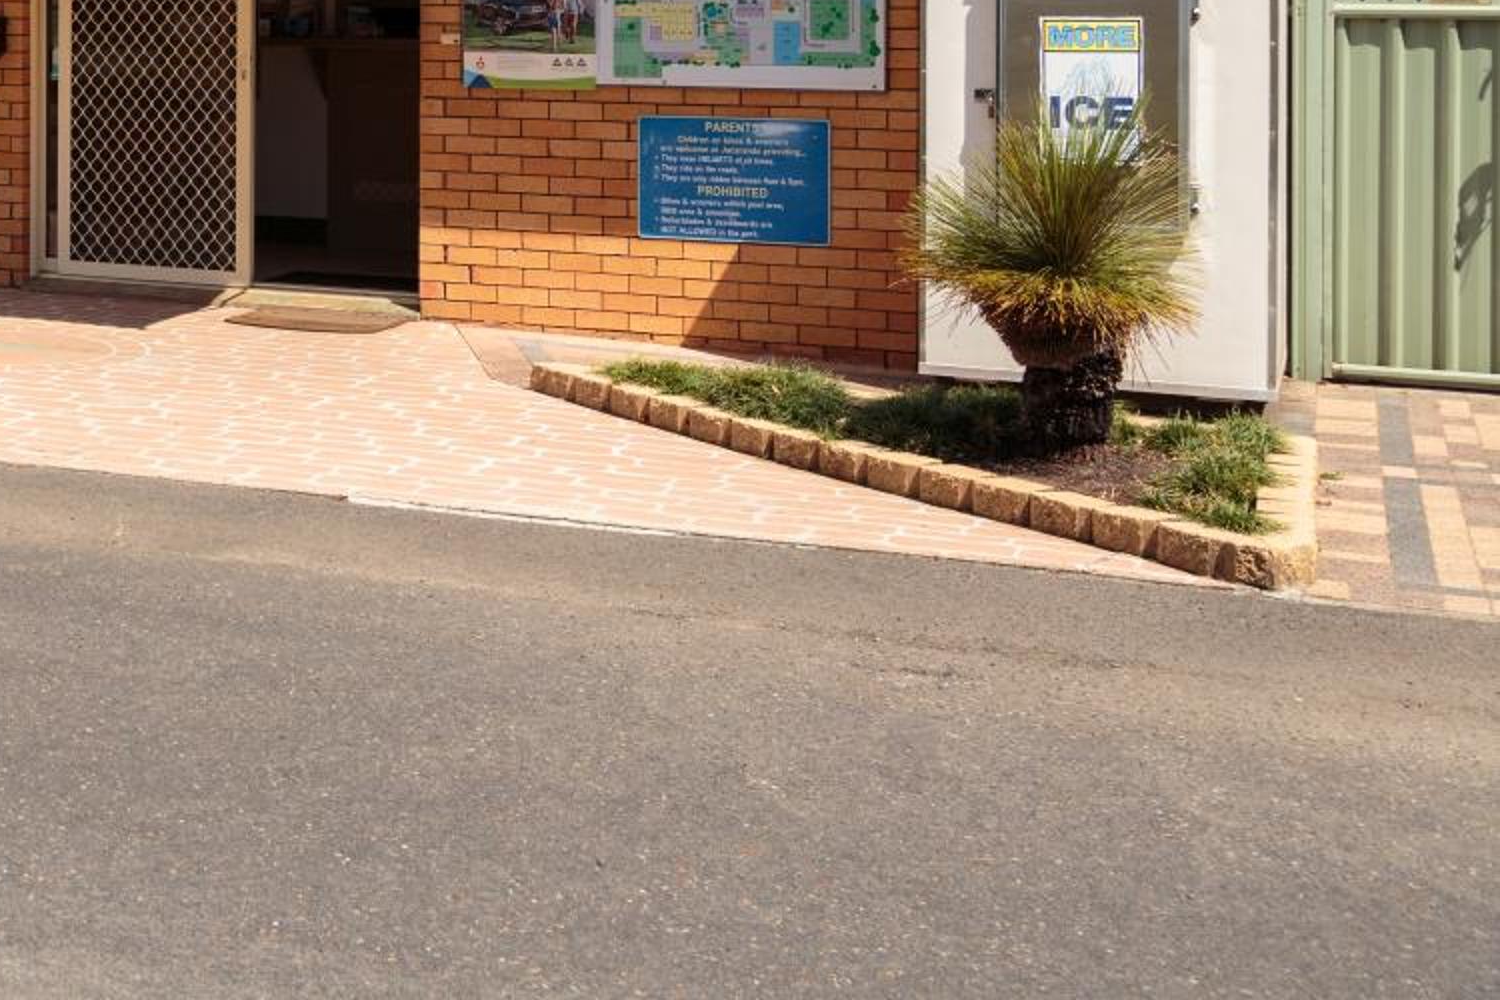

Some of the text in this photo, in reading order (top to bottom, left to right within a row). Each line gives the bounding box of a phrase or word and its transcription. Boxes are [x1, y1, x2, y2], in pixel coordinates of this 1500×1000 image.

[1048, 25, 1137, 48] MORE
[1049, 95, 1135, 130] ICE
[704, 121, 759, 133] PARENTS
[661, 154, 677, 164] They
[661, 163, 677, 174] They
[661, 173, 677, 184] They
[697, 184, 769, 199] PROHIBITED
